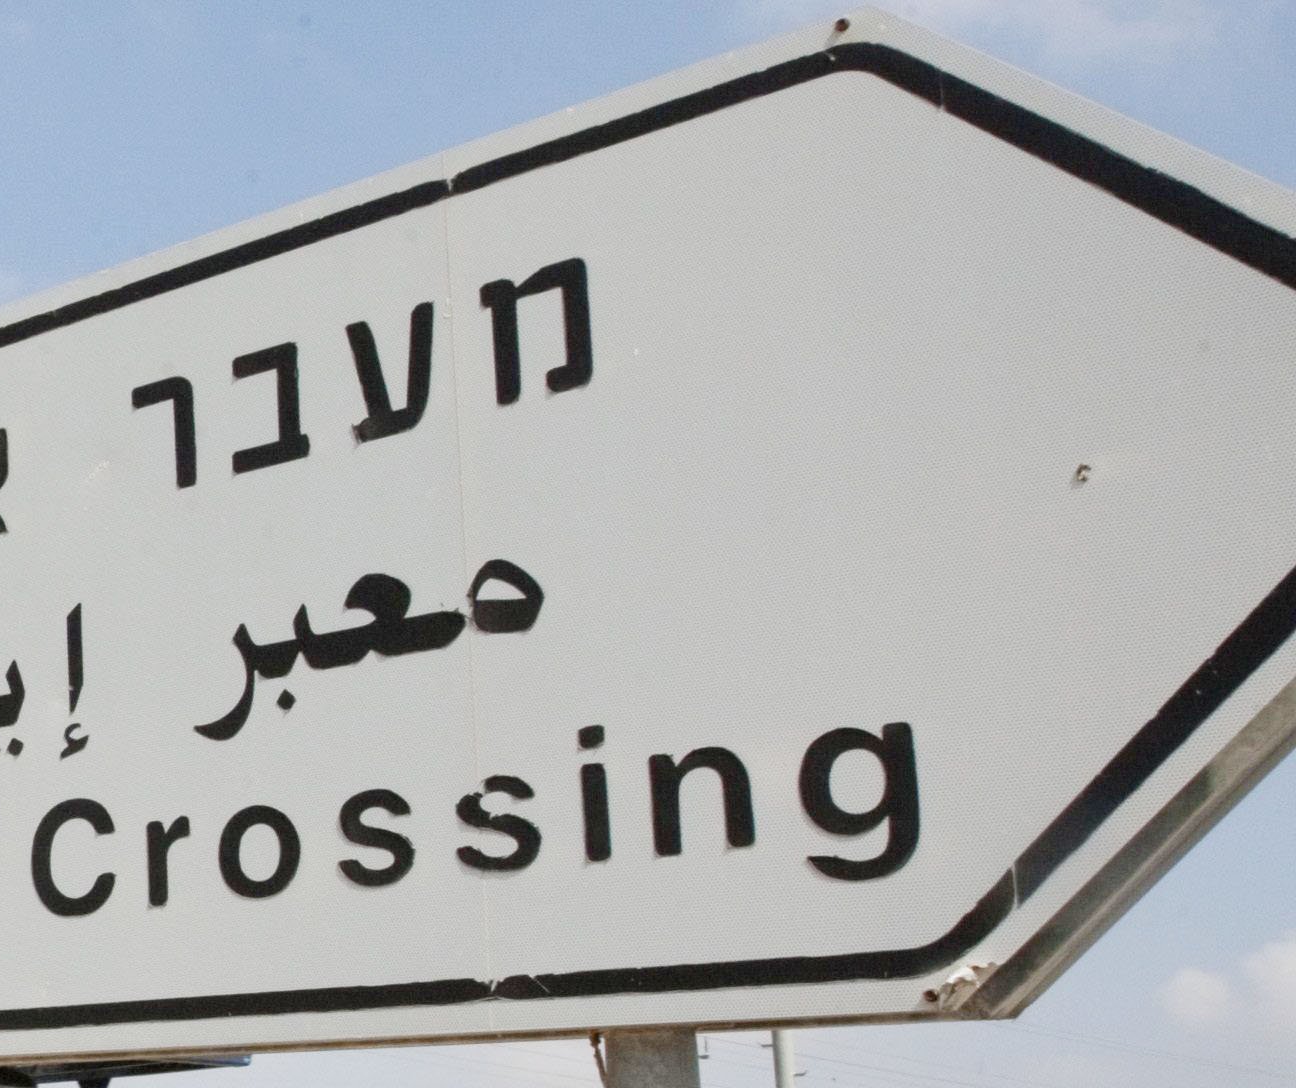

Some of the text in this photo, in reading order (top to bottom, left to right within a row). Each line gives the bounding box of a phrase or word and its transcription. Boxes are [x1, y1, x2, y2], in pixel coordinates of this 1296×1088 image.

[131, 257, 595, 489] מעבר
[193, 558, 545, 741] معبر
[31, 721, 921, 917] Crossing
